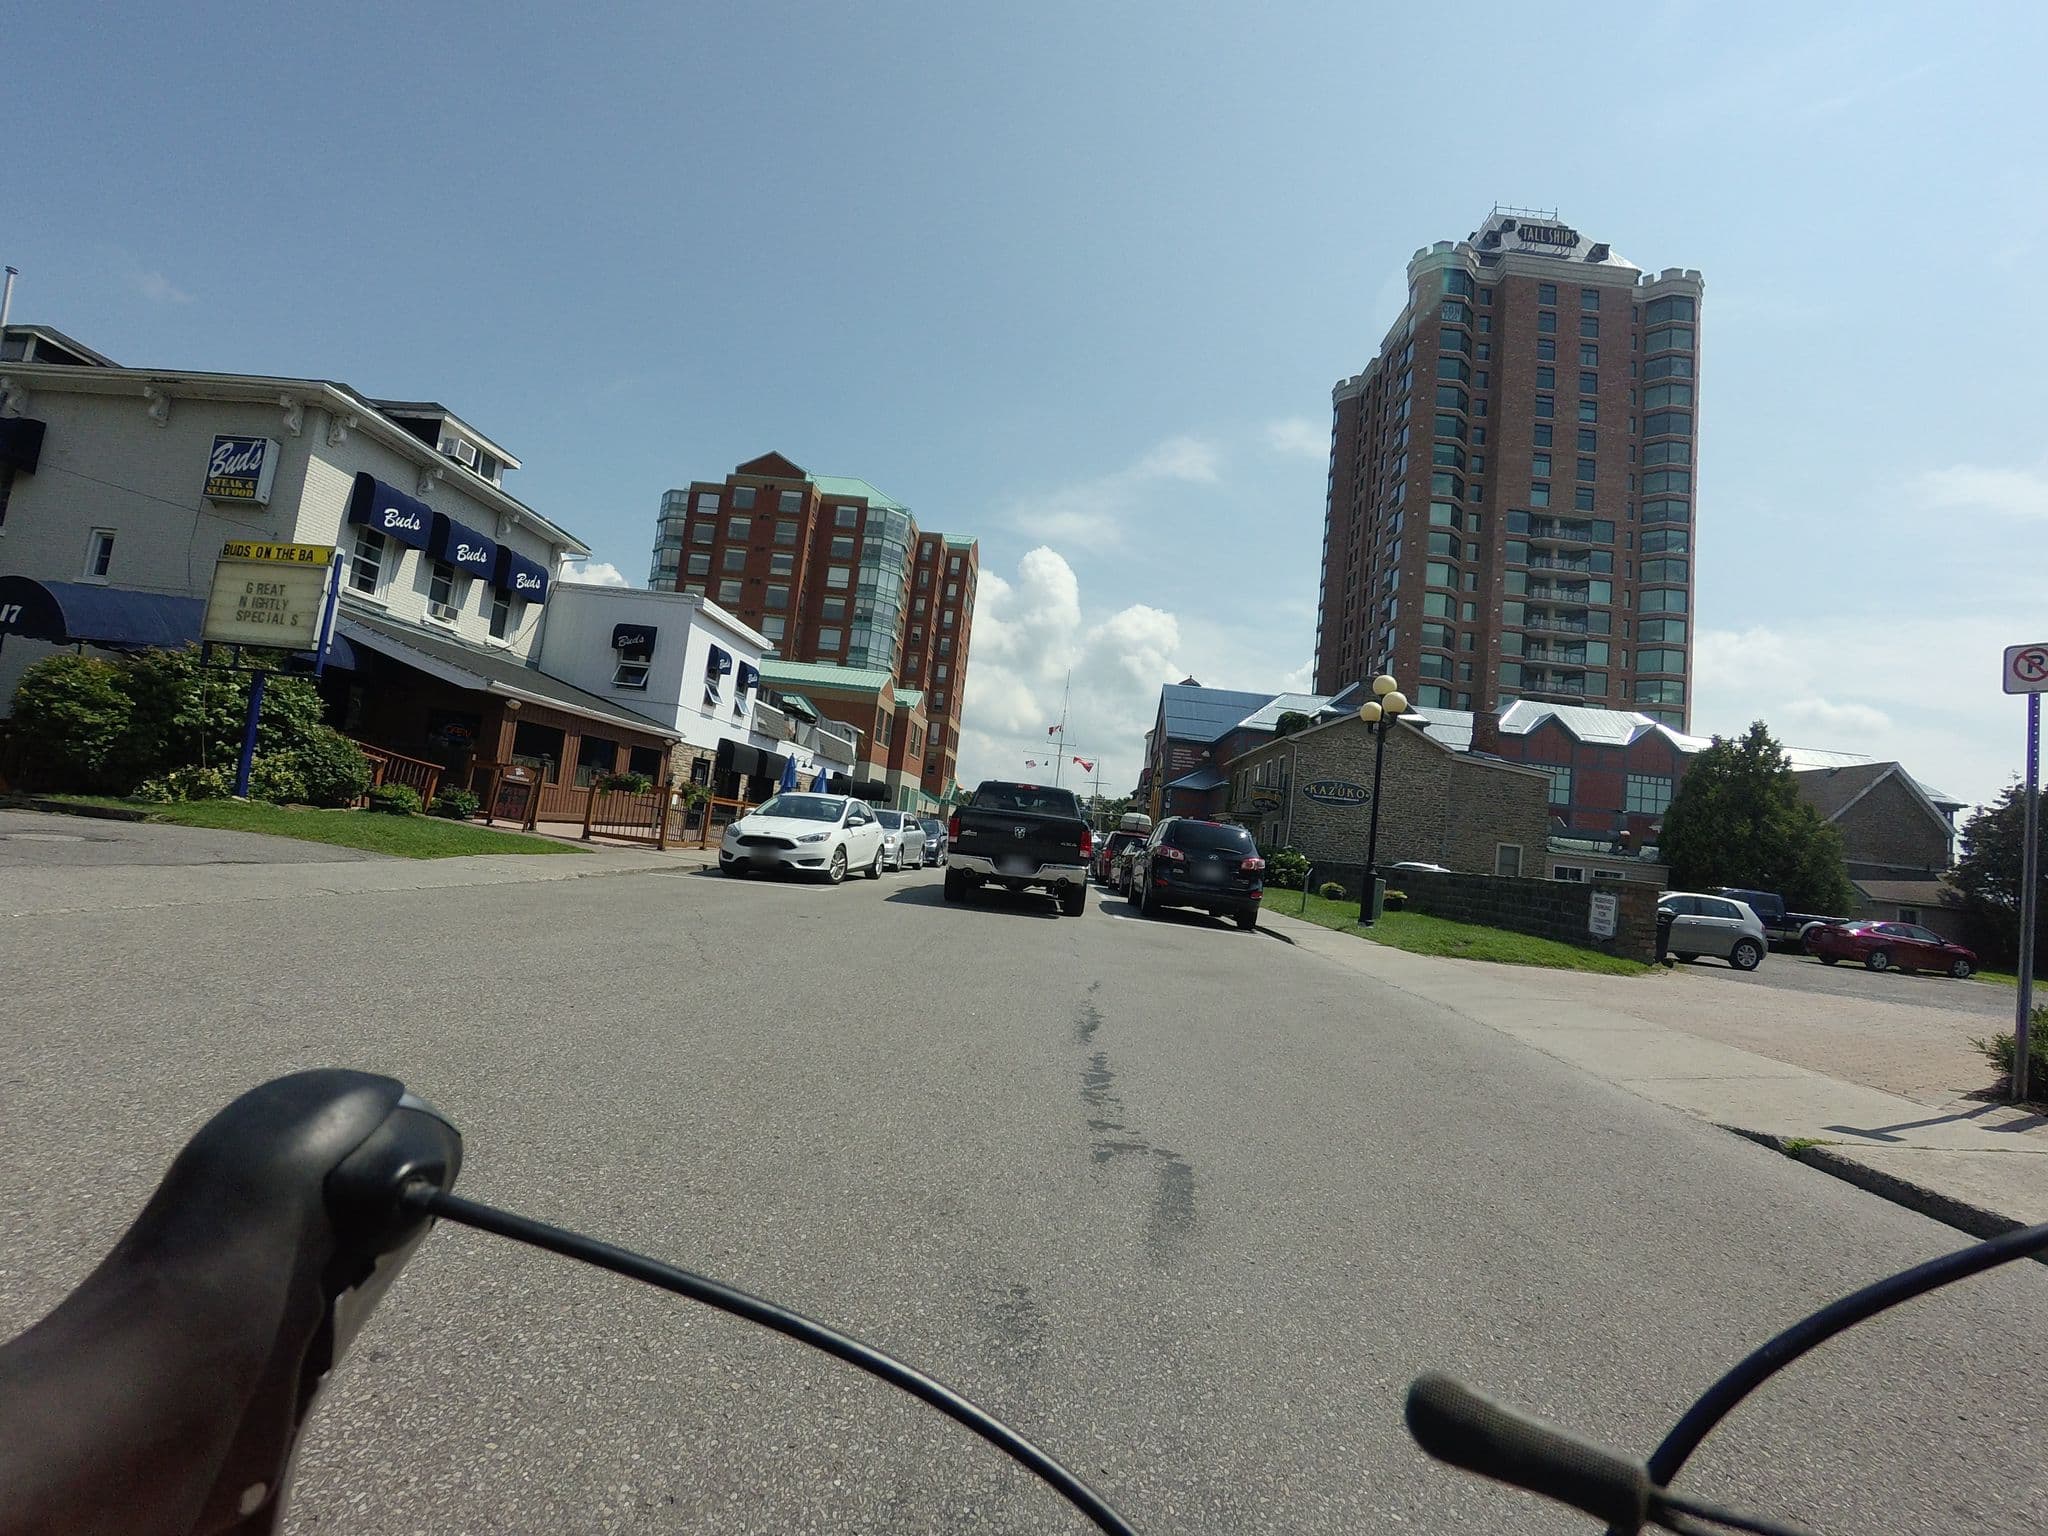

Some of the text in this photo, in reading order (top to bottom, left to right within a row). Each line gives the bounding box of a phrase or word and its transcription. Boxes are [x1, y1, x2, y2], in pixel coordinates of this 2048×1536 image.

[1523, 226, 1576, 246] TALL SHIPS
[209, 478, 243, 488] STEAK
[206, 486, 255, 497] SEAFOOD
[383, 508, 421, 530] Buds
[223, 543, 251, 557] BUDS
[255, 546, 272, 559] ON
[275, 547, 296, 560] THE
[456, 543, 487, 563] Buds
[516, 573, 541, 589] Buds
[1310, 784, 1365, 799] KAZUKO
